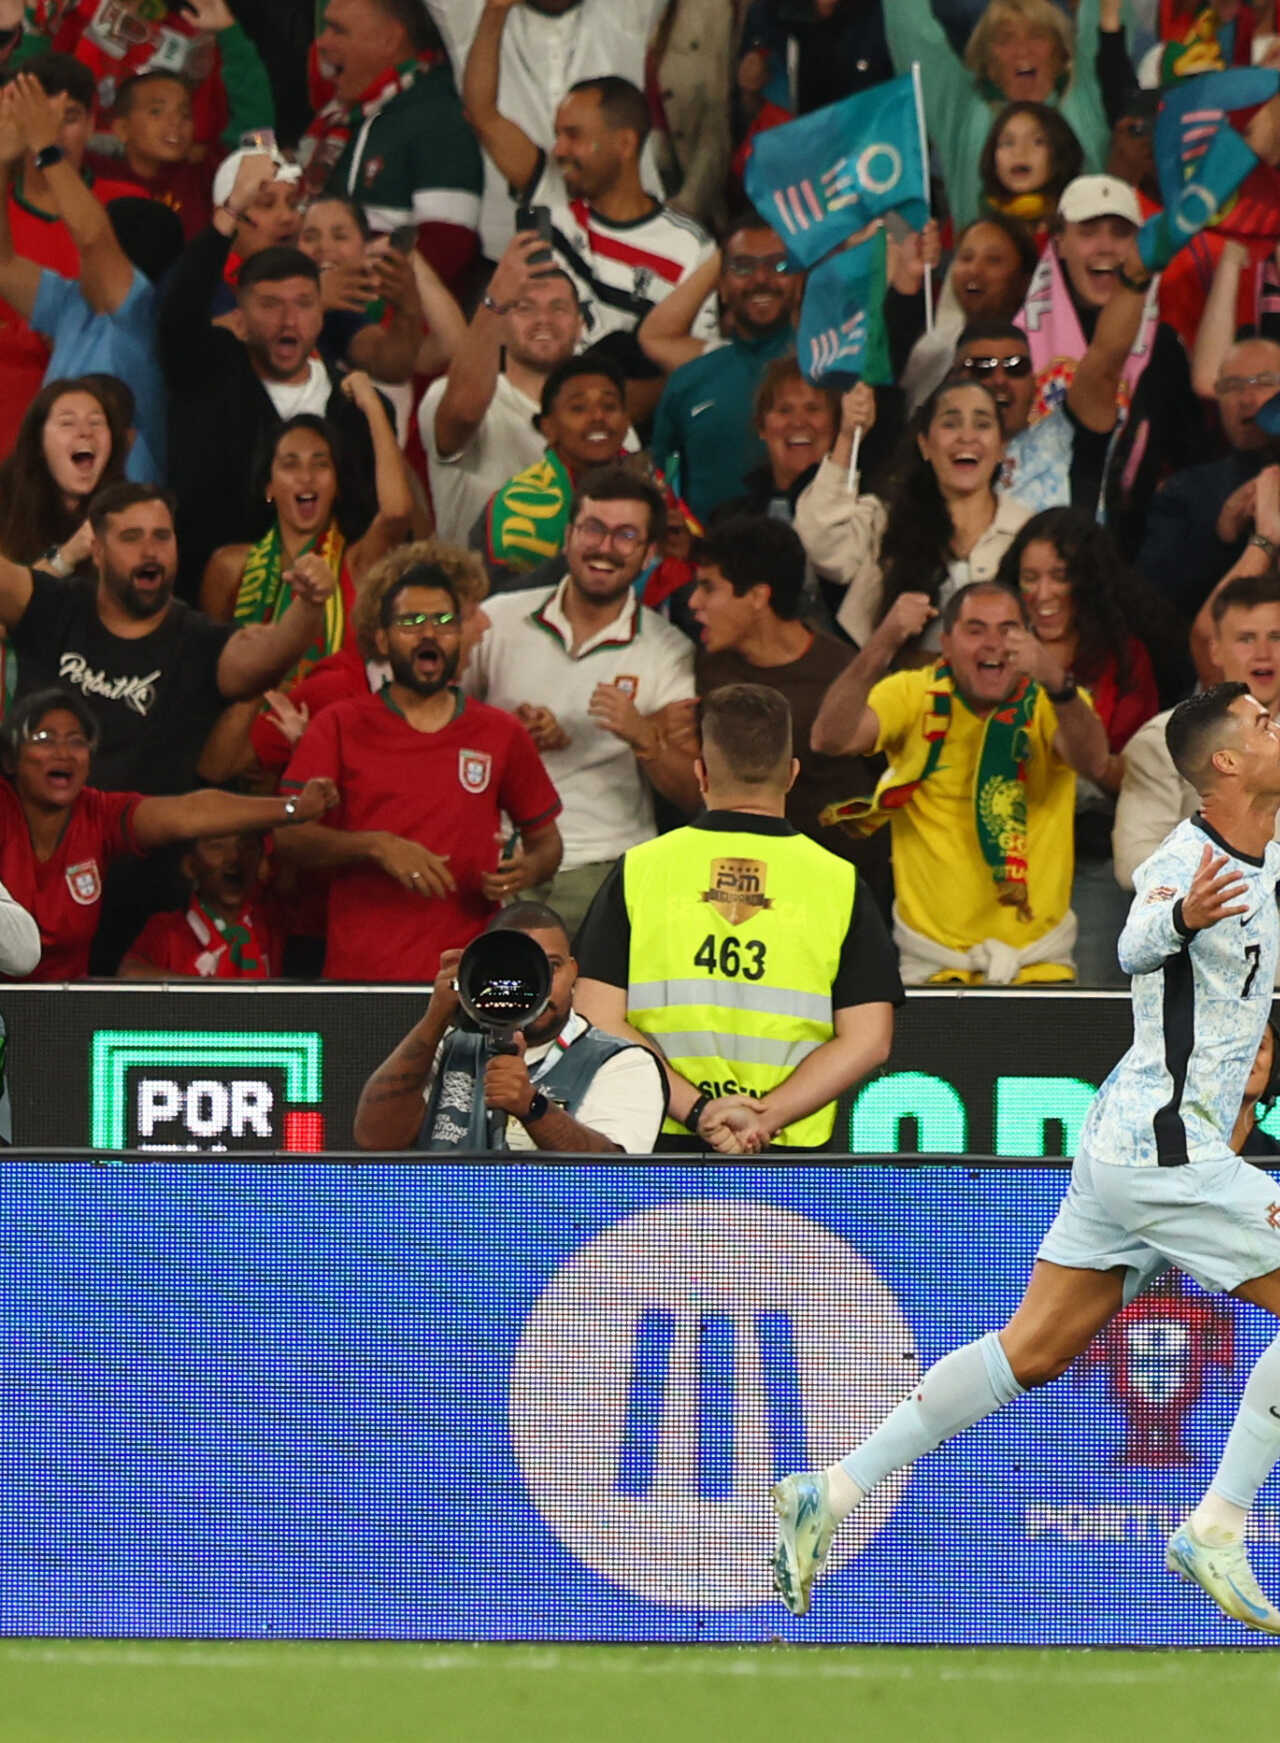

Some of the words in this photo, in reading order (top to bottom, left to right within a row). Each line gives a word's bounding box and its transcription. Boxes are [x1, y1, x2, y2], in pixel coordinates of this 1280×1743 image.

[693, 934, 767, 981] 463
[1240, 944, 1261, 1000] 7
[137, 1079, 273, 1137] POR
